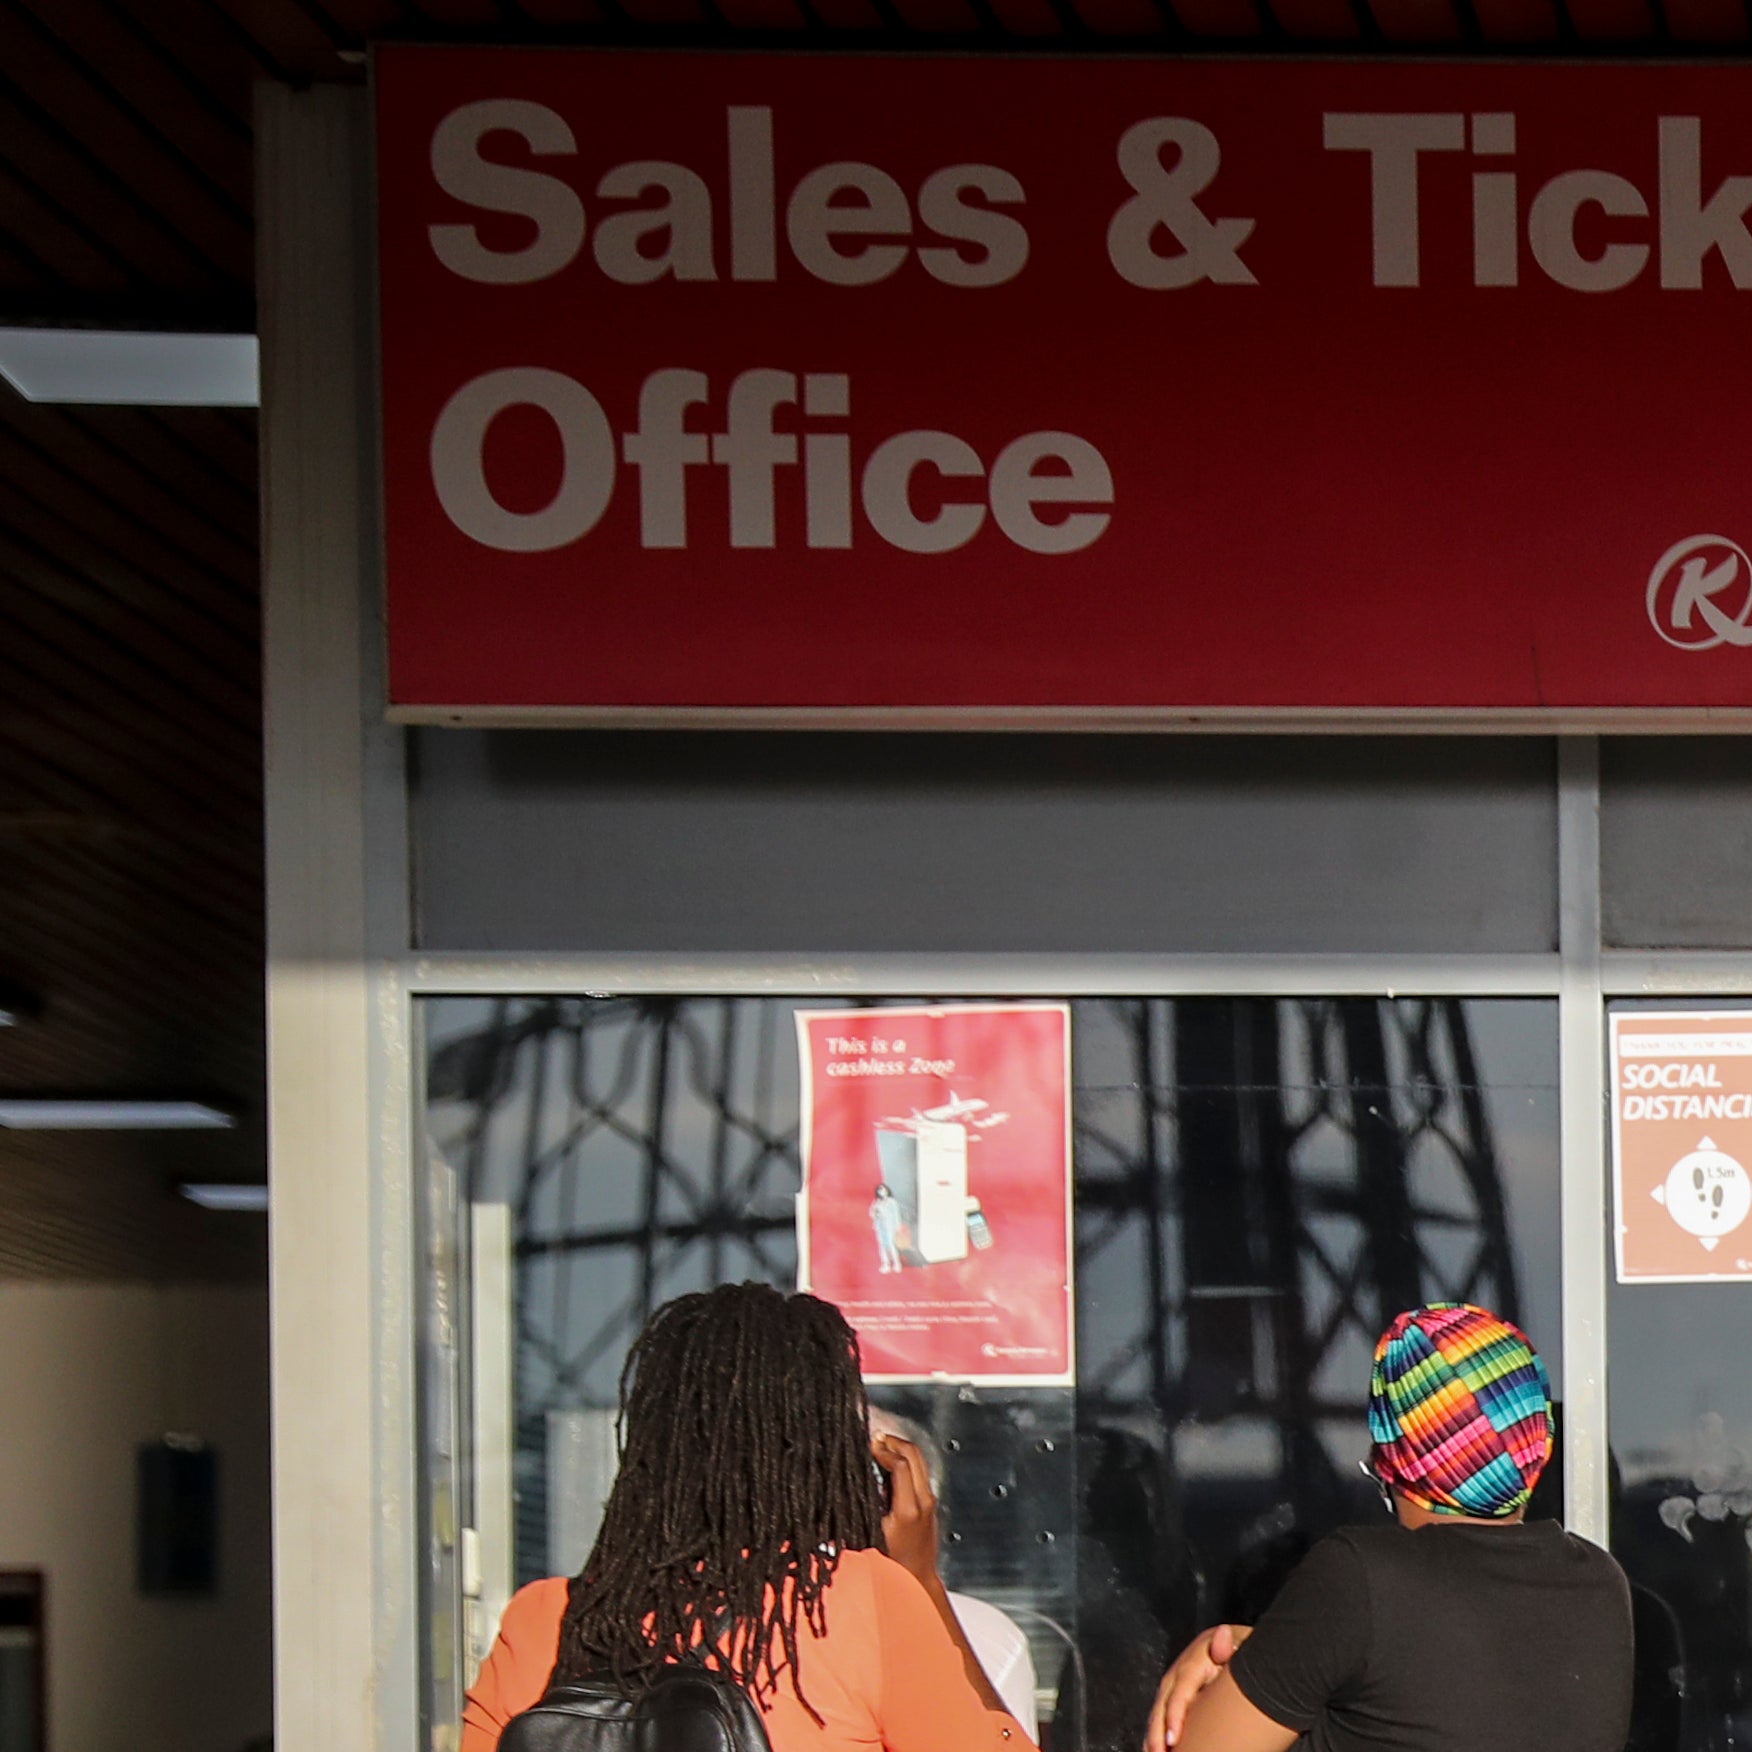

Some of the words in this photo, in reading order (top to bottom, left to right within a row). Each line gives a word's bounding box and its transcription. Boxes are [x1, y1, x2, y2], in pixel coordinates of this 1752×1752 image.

[429, 99, 1029, 288] Sales
[1106, 116, 1259, 290] &
[430, 368, 1115, 554] Office
[826, 1037, 867, 1055] This
[871, 1037, 887, 1054] is
[892, 1039, 906, 1054] a
[825, 1058, 904, 1077] cashless
[908, 1057, 955, 1076] Zone
[1622, 1064, 1722, 1090] SOCIAL
